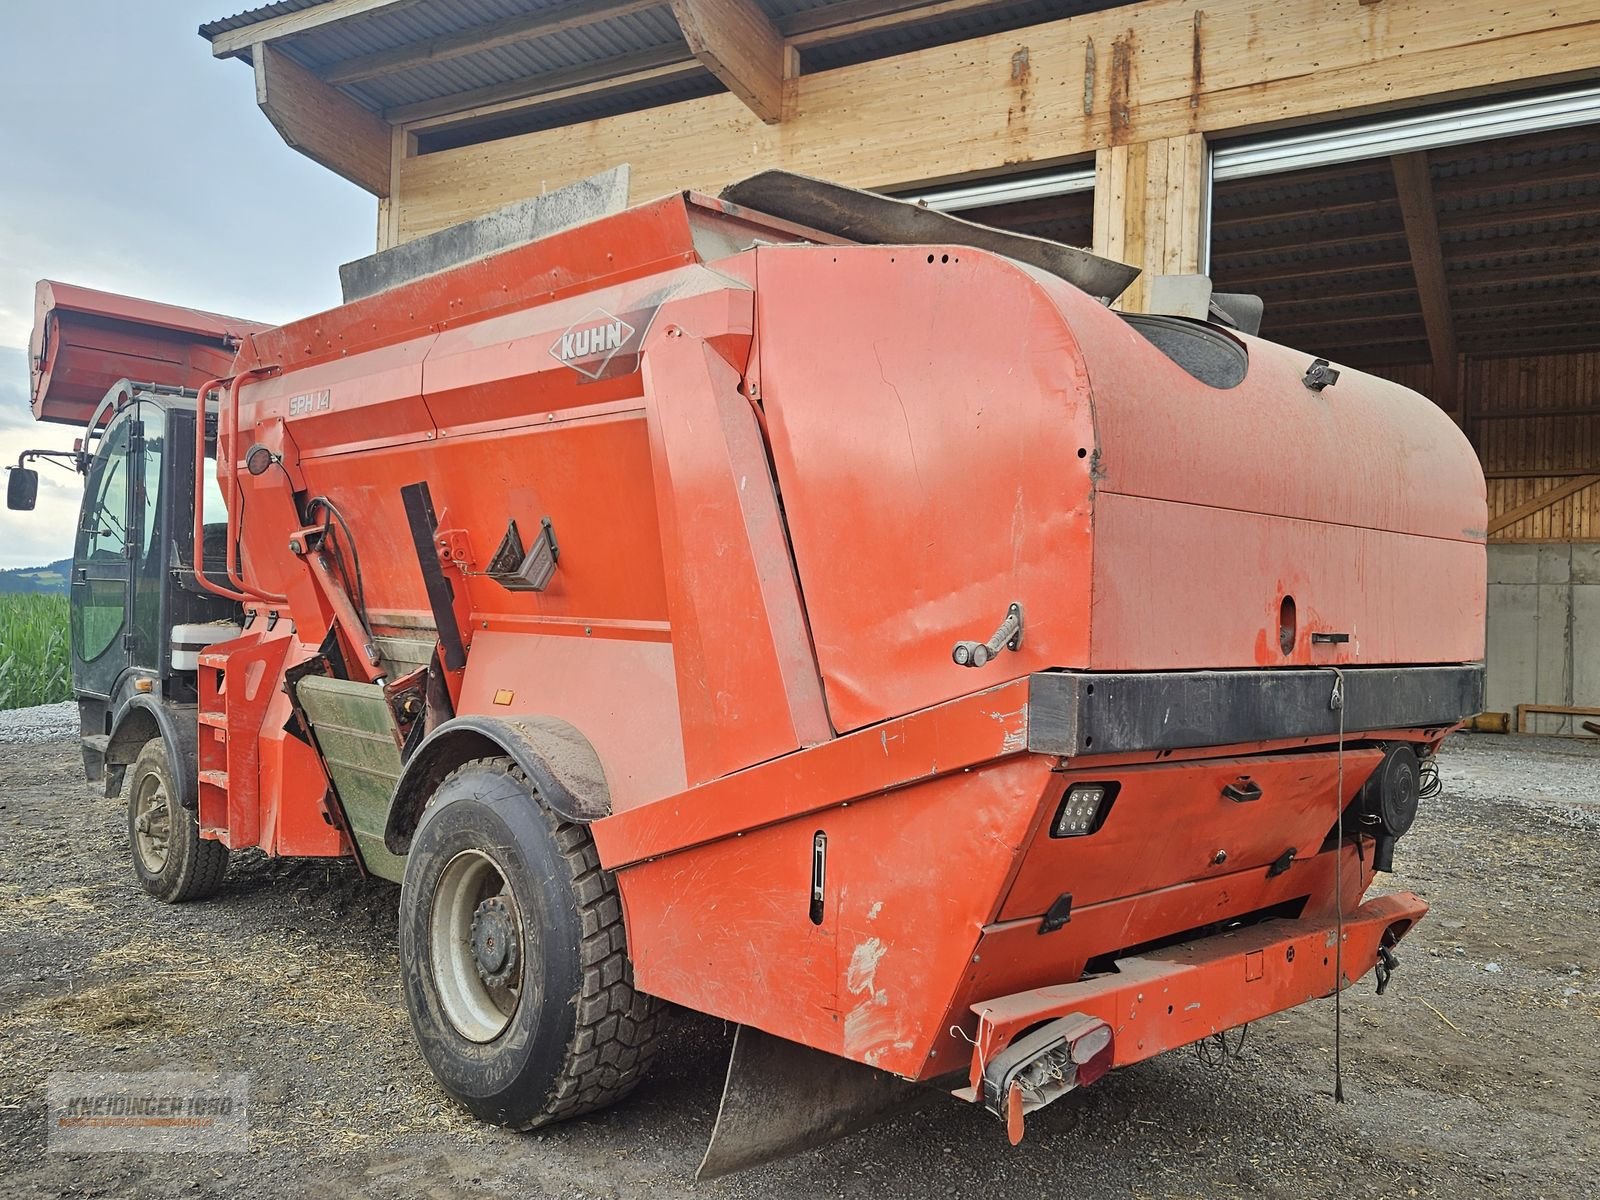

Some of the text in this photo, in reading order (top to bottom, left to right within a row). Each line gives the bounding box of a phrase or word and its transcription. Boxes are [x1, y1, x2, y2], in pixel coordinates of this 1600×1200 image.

[561, 321, 622, 360] KUHN
[289, 390, 330, 416] SPH 14
